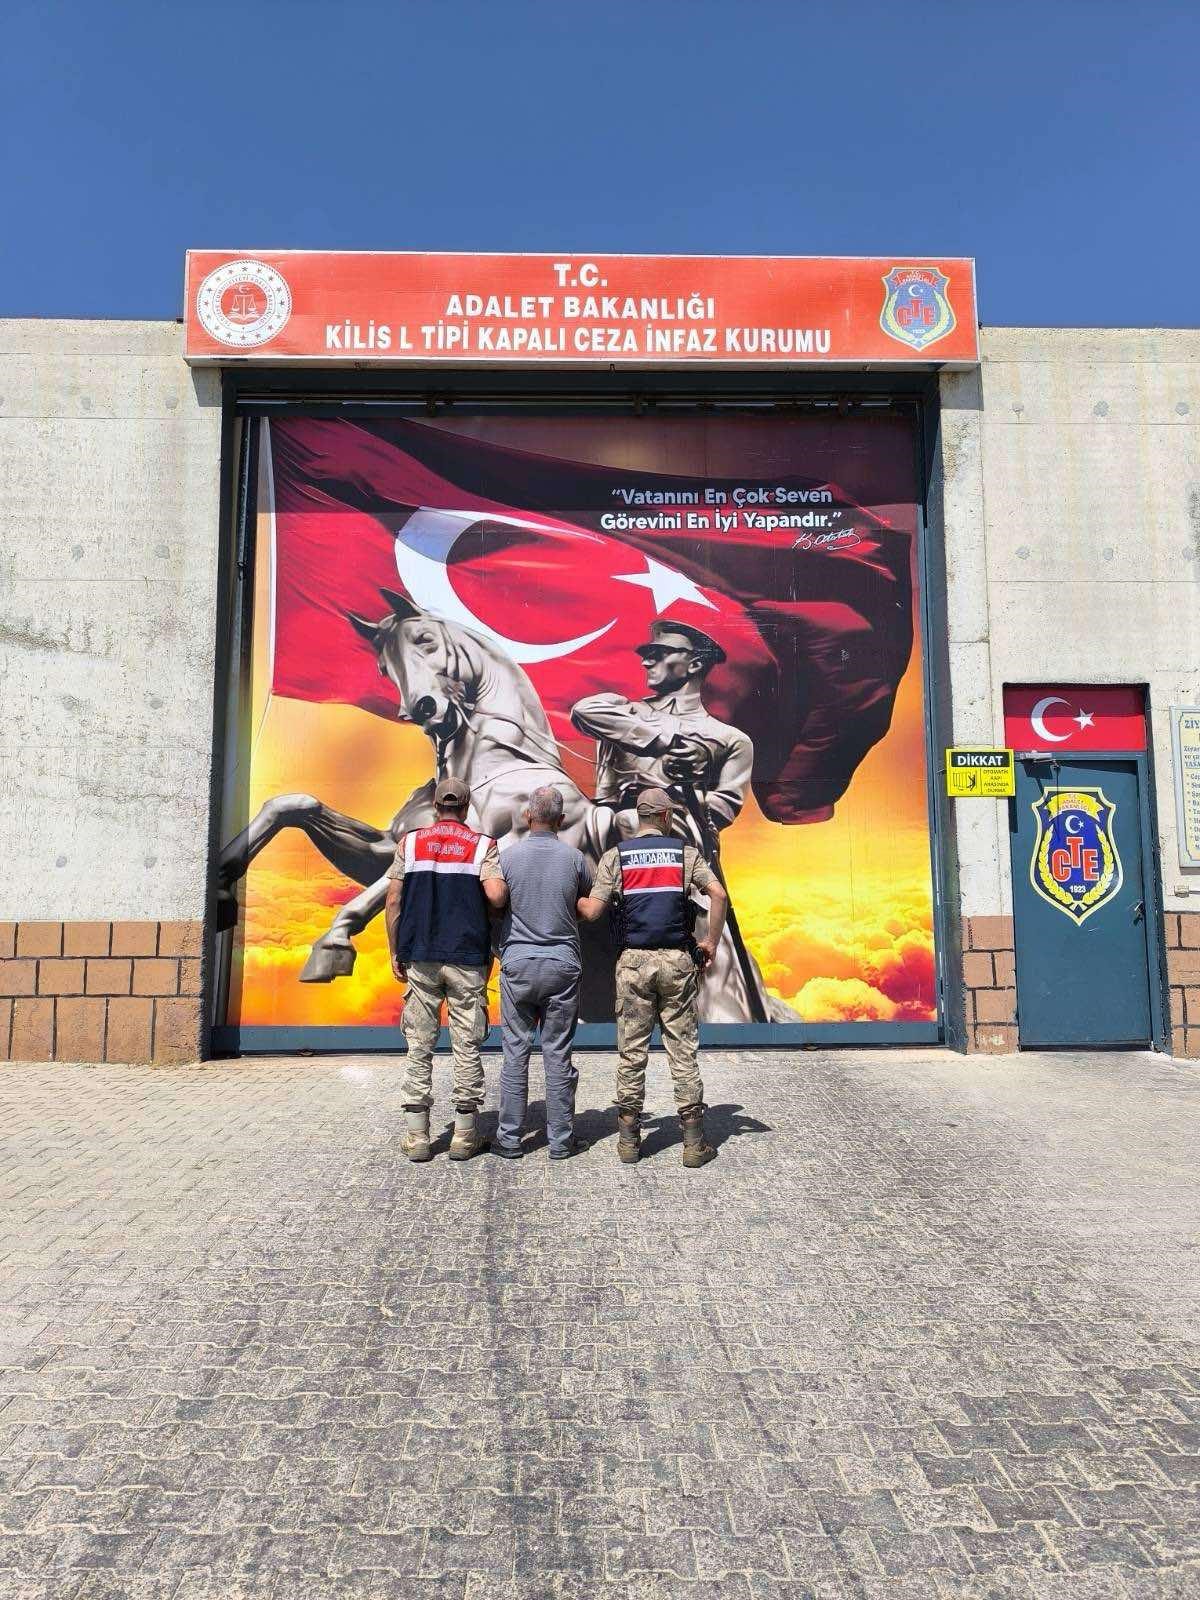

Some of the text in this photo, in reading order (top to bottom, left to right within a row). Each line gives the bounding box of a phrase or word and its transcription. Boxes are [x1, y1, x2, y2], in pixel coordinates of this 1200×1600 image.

[553, 263, 608, 287] T.C.
[446, 293, 715, 320] ADALET BAKANLIĞI
[325, 321, 831, 353] KİLİS L TİPİ KAPALI CEZA İNFAZ KURUMU
[611, 487, 833, 508] “Vatanını En Çok Seven
[600, 509, 842, 532] Görevini En İyi Yapandır.”
[957, 753, 1004, 766] DİKKAT
[418, 825, 480, 844] JANDARMA
[627, 851, 677, 865] JANDARMA
[1052, 836, 1100, 882] CTE
[1069, 885, 1087, 894] 1923
